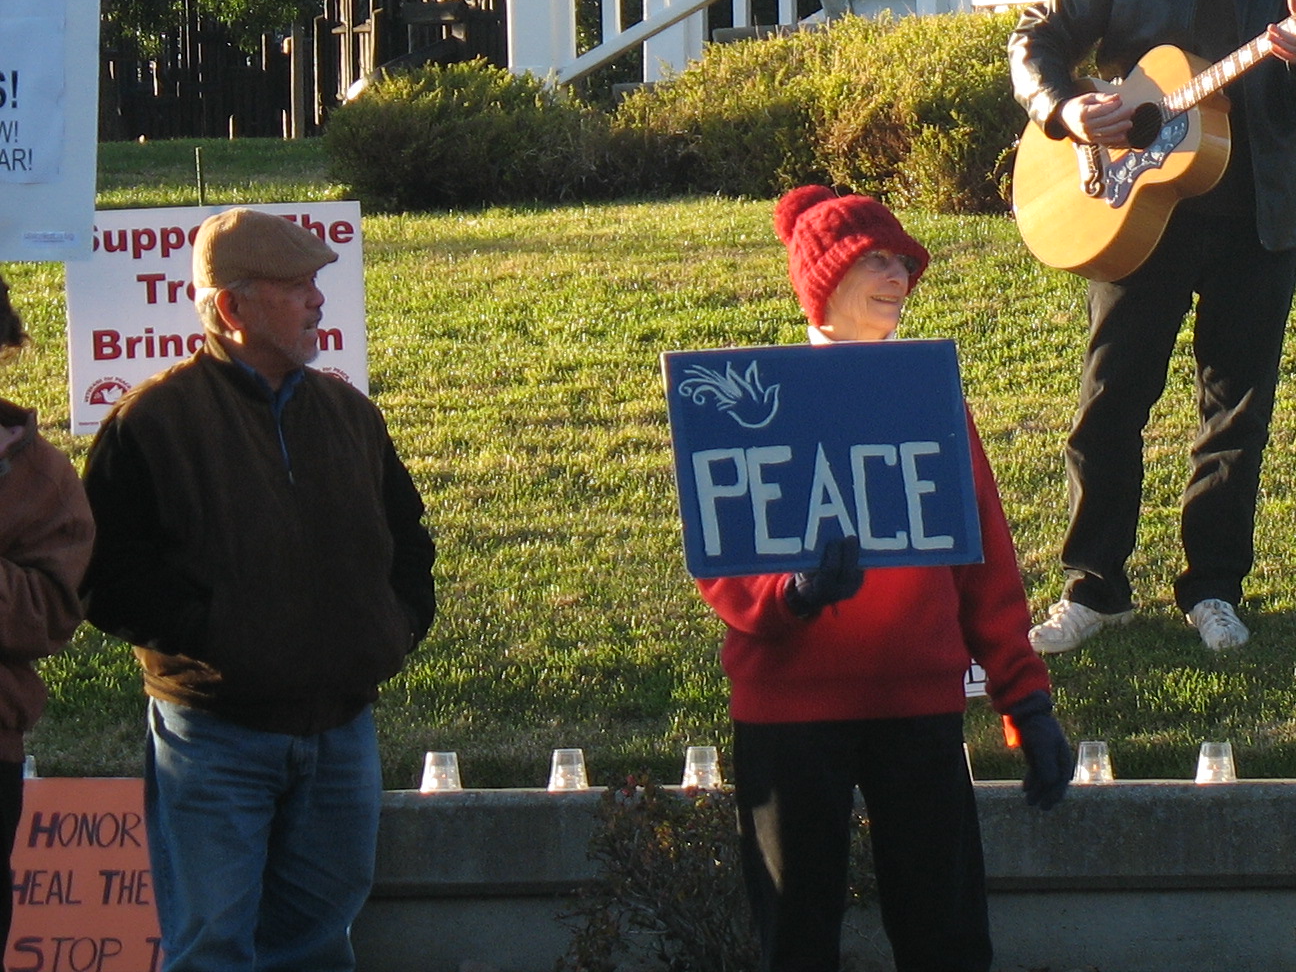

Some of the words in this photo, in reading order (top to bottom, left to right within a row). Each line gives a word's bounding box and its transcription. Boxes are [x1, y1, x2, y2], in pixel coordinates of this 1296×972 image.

[281, 213, 354, 244] he
[692, 442, 954, 557] PEACE
[27, 811, 141, 848] HONOR
[11, 869, 82, 905] HEAL
[99, 869, 150, 905] THE
[9, 936, 122, 972] STOP
